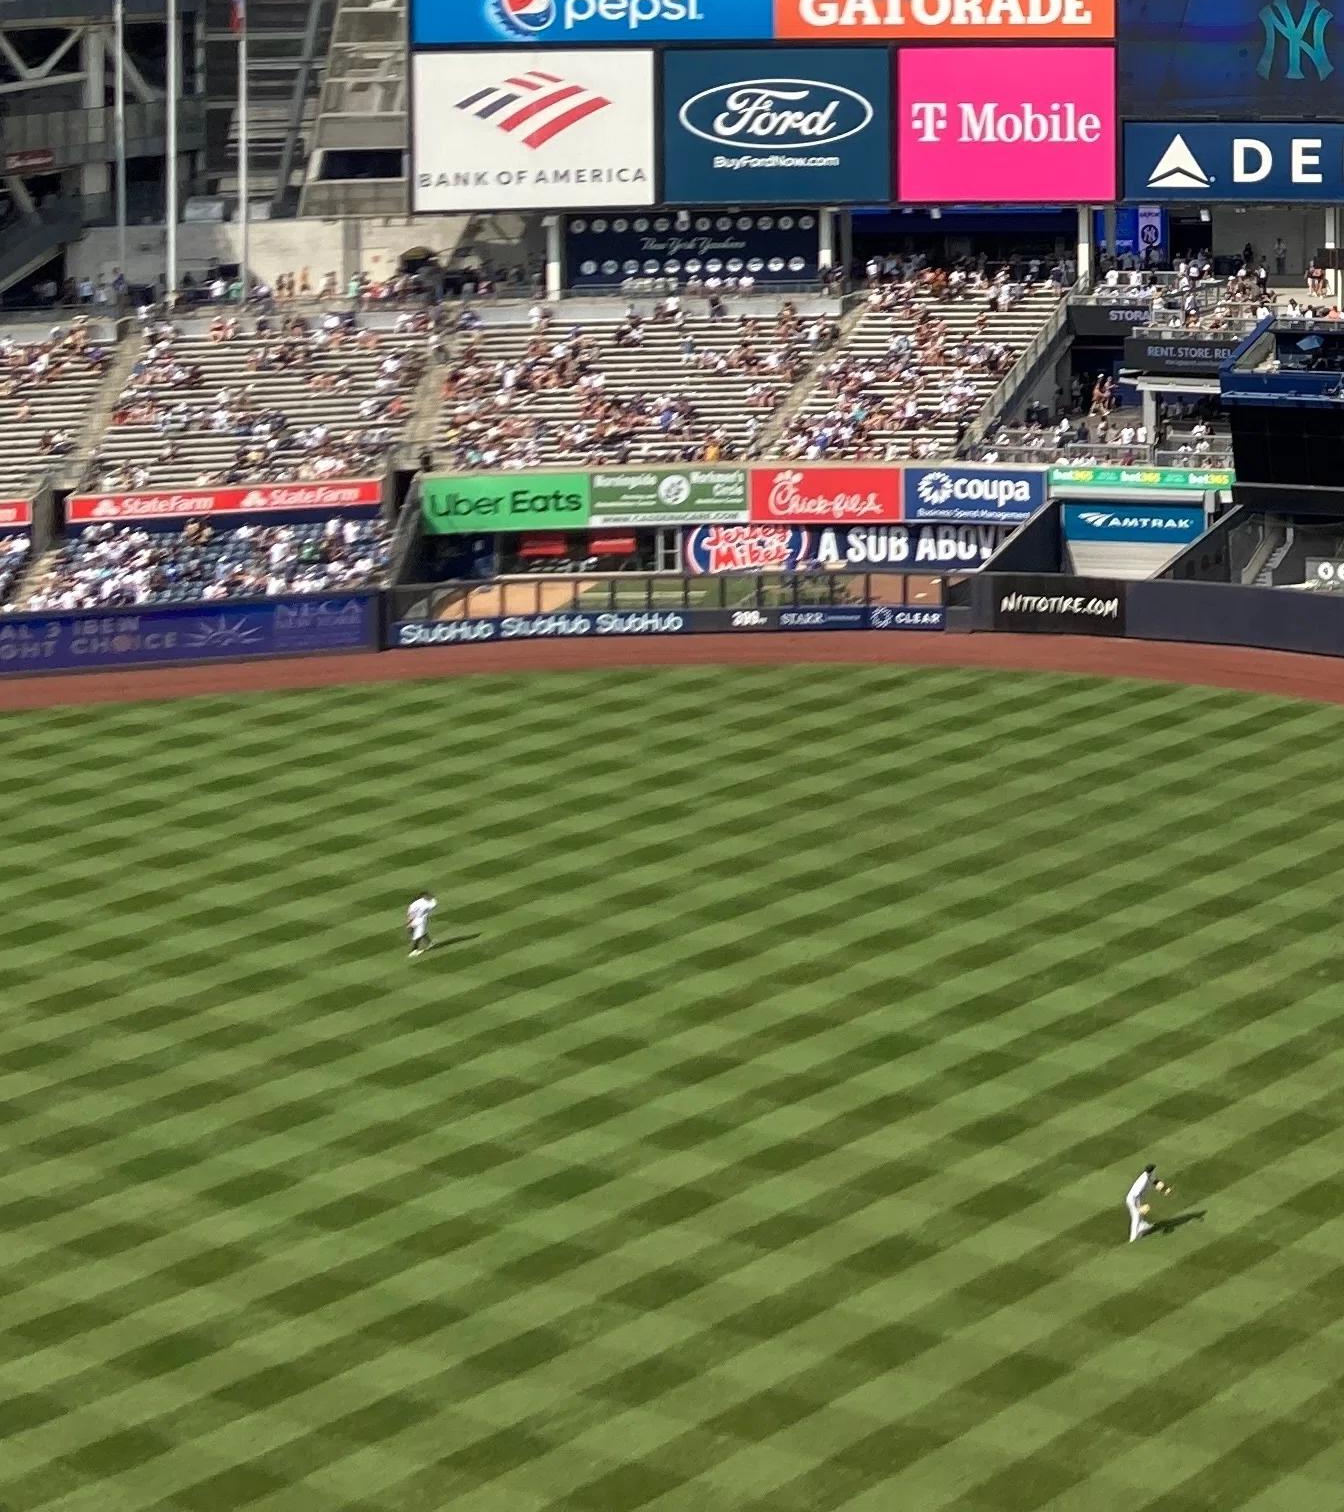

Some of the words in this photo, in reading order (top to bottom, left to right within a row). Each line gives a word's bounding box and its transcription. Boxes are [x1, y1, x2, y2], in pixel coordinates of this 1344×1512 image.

[713, 88, 837, 139] Ford
[957, 102, 1100, 143] Mobile
[419, 171, 493, 189] BANK
[499, 169, 529, 186] OF
[533, 167, 648, 185] AMERICA
[428, 492, 504, 518] Uber
[509, 489, 582, 514] Eats
[953, 476, 1031, 504] coupa
[1108, 517, 1191, 529] AMTRAK
[818, 530, 839, 563] A
[847, 528, 908, 562] SUB
[1001, 591, 1118, 617] NITTOTIRE.COM
[400, 620, 494, 645] StubHub
[500, 614, 591, 638] StubHub
[596, 610, 683, 634] StubHub
